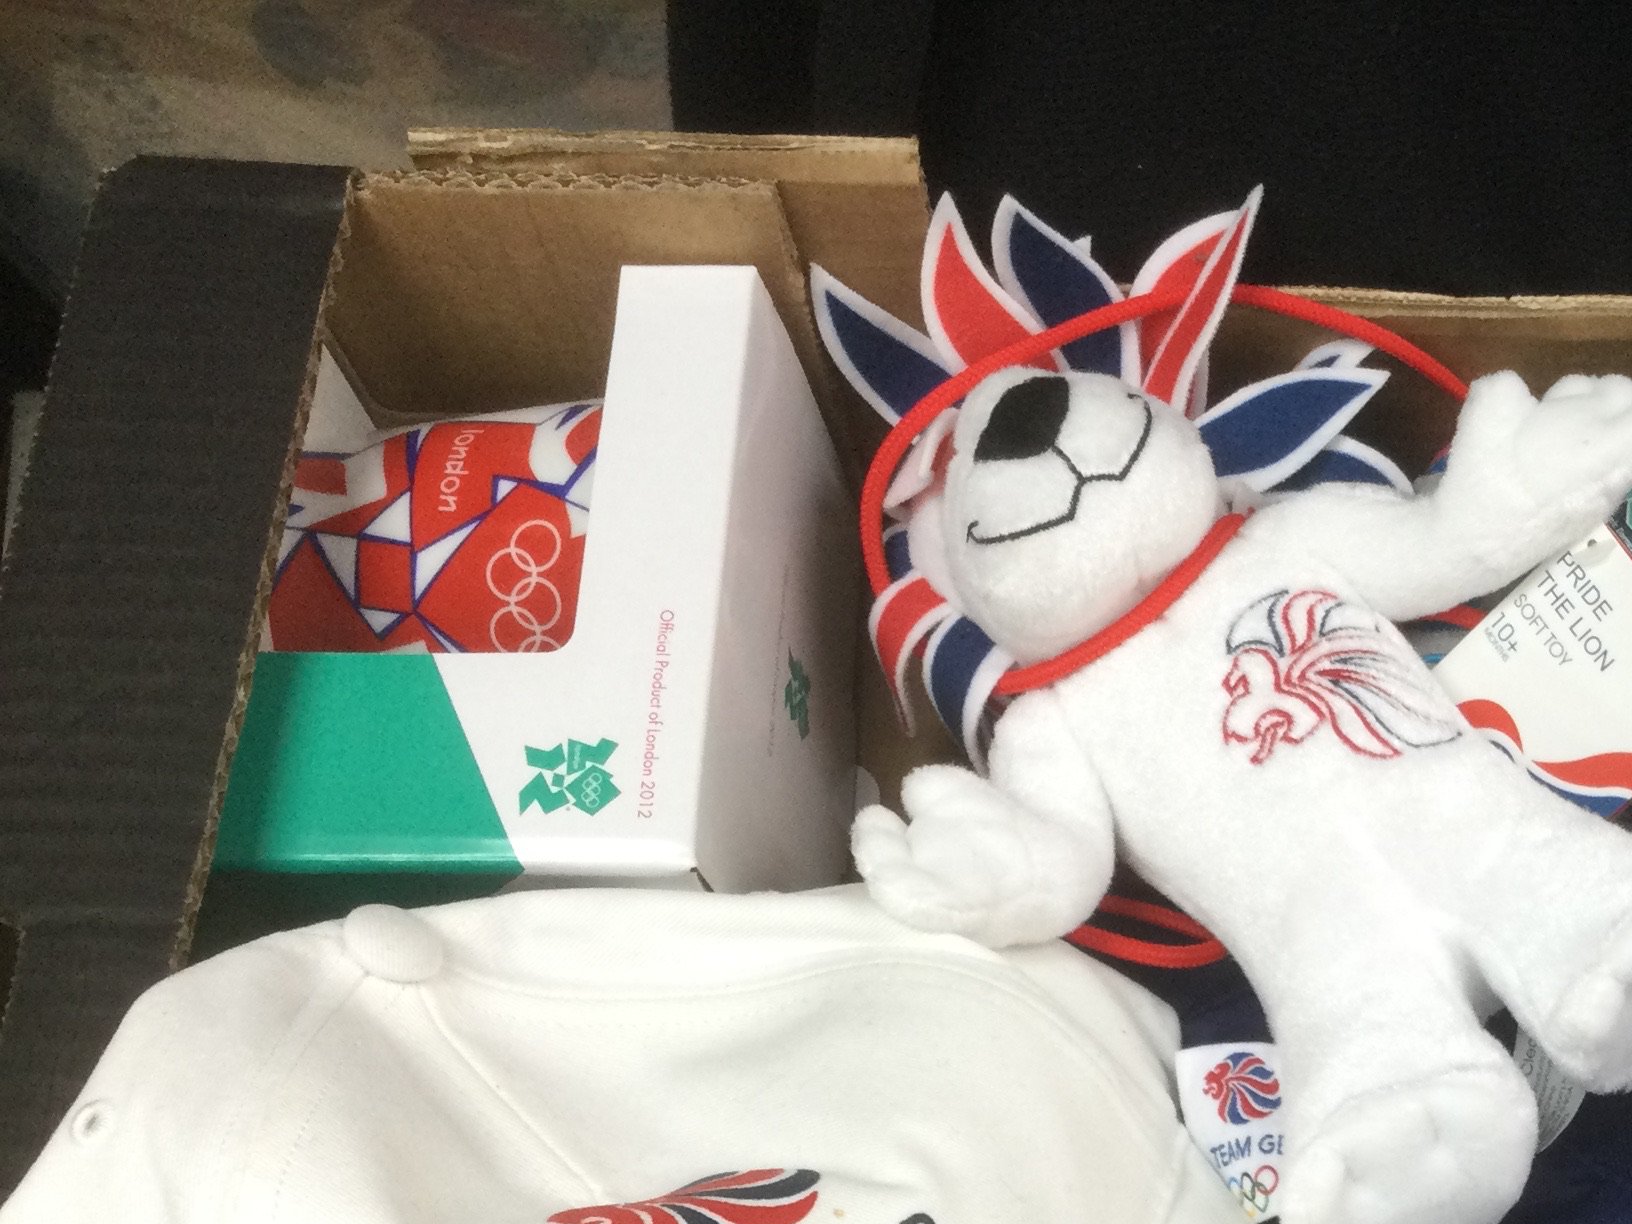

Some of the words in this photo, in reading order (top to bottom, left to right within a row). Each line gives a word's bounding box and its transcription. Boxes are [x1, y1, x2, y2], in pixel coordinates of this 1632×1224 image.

[437, 429, 485, 512] london
[1557, 550, 1613, 622] PRIDE
[657, 609, 675, 656] Official
[1491, 611, 1519, 653] 10+
[1514, 593, 1550, 636] SOFT
[1543, 632, 1573, 666] TOY
[1537, 569, 1576, 620] THE
[1568, 616, 1615, 672] LION
[650, 659, 669, 709] Product
[648, 711, 664, 726] of
[637, 781, 656, 819] 2012
[1210, 1136, 1251, 1169] TEAM
